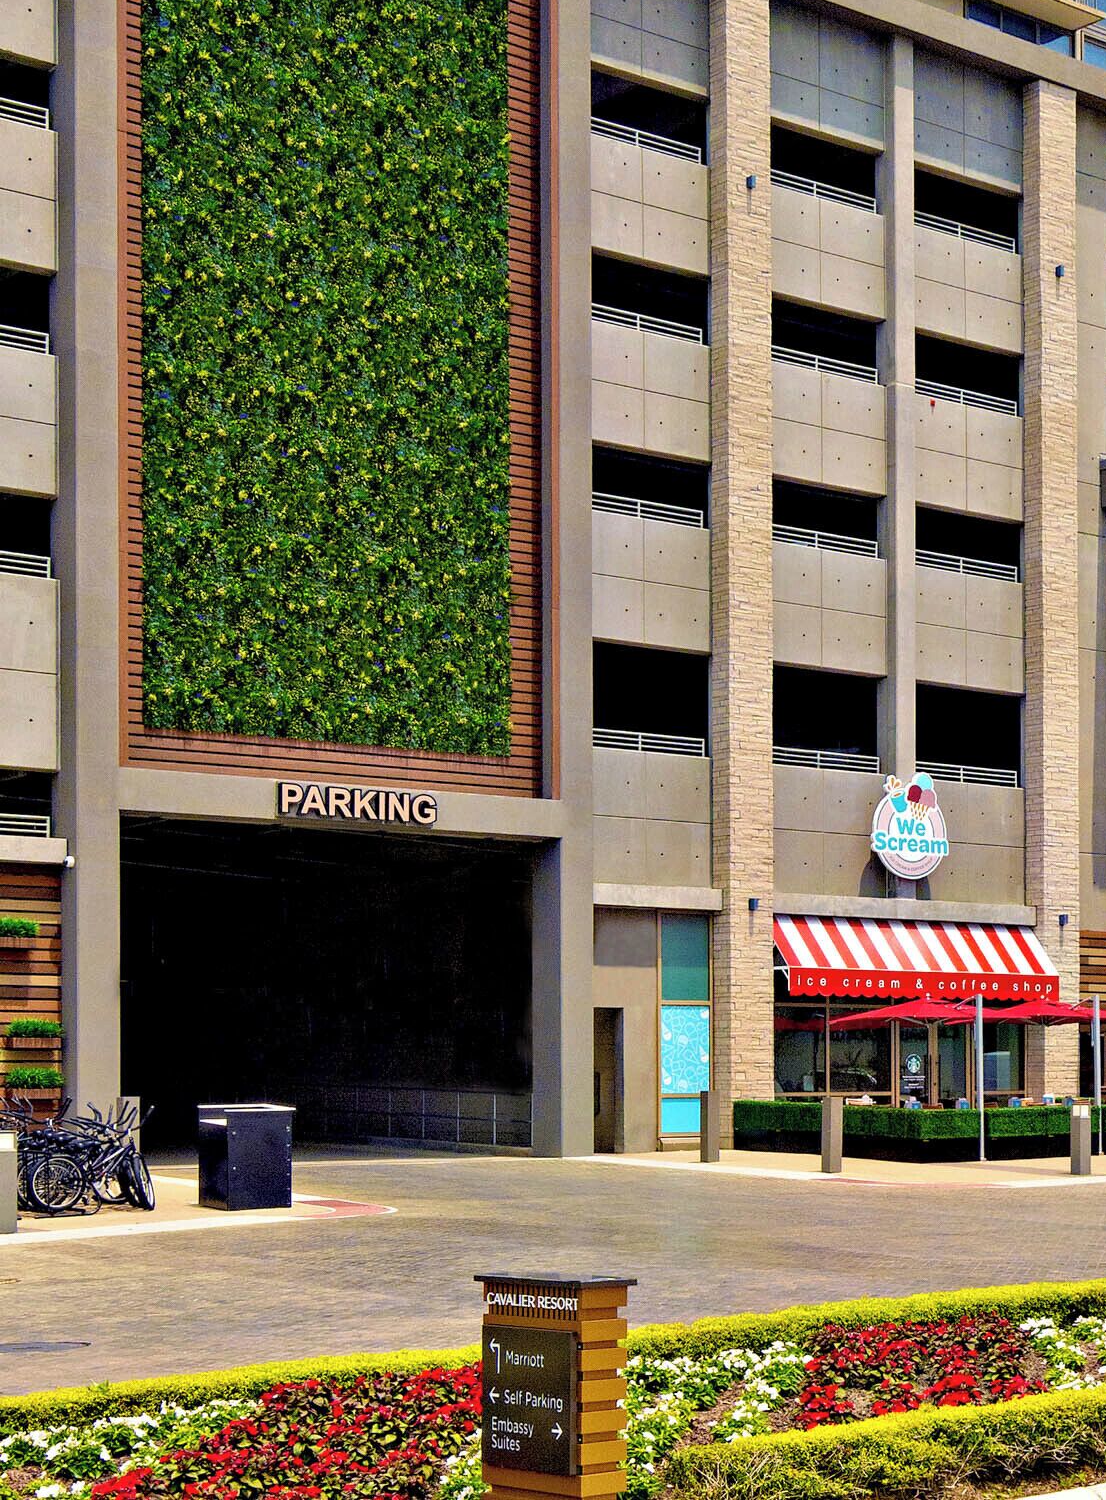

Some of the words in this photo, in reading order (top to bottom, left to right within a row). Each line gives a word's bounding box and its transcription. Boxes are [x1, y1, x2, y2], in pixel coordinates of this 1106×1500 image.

[278, 782, 437, 825] PARKING
[897, 817, 926, 837] We
[874, 831, 948, 855] Scream
[797, 974, 827, 987] ice
[843, 978, 900, 989] cream
[915, 978, 924, 989] &
[938, 979, 999, 992] coffee
[1012, 981, 1053, 995] shop
[486, 1292, 536, 1308] CAVALIER
[538, 1296, 579, 1312] RESORT
[505, 1350, 545, 1368] Marriott
[503, 1389, 523, 1405] Self
[525, 1392, 563, 1413] Parking
[491, 1415, 534, 1438] Embassy
[491, 1433, 521, 1451] Suites
